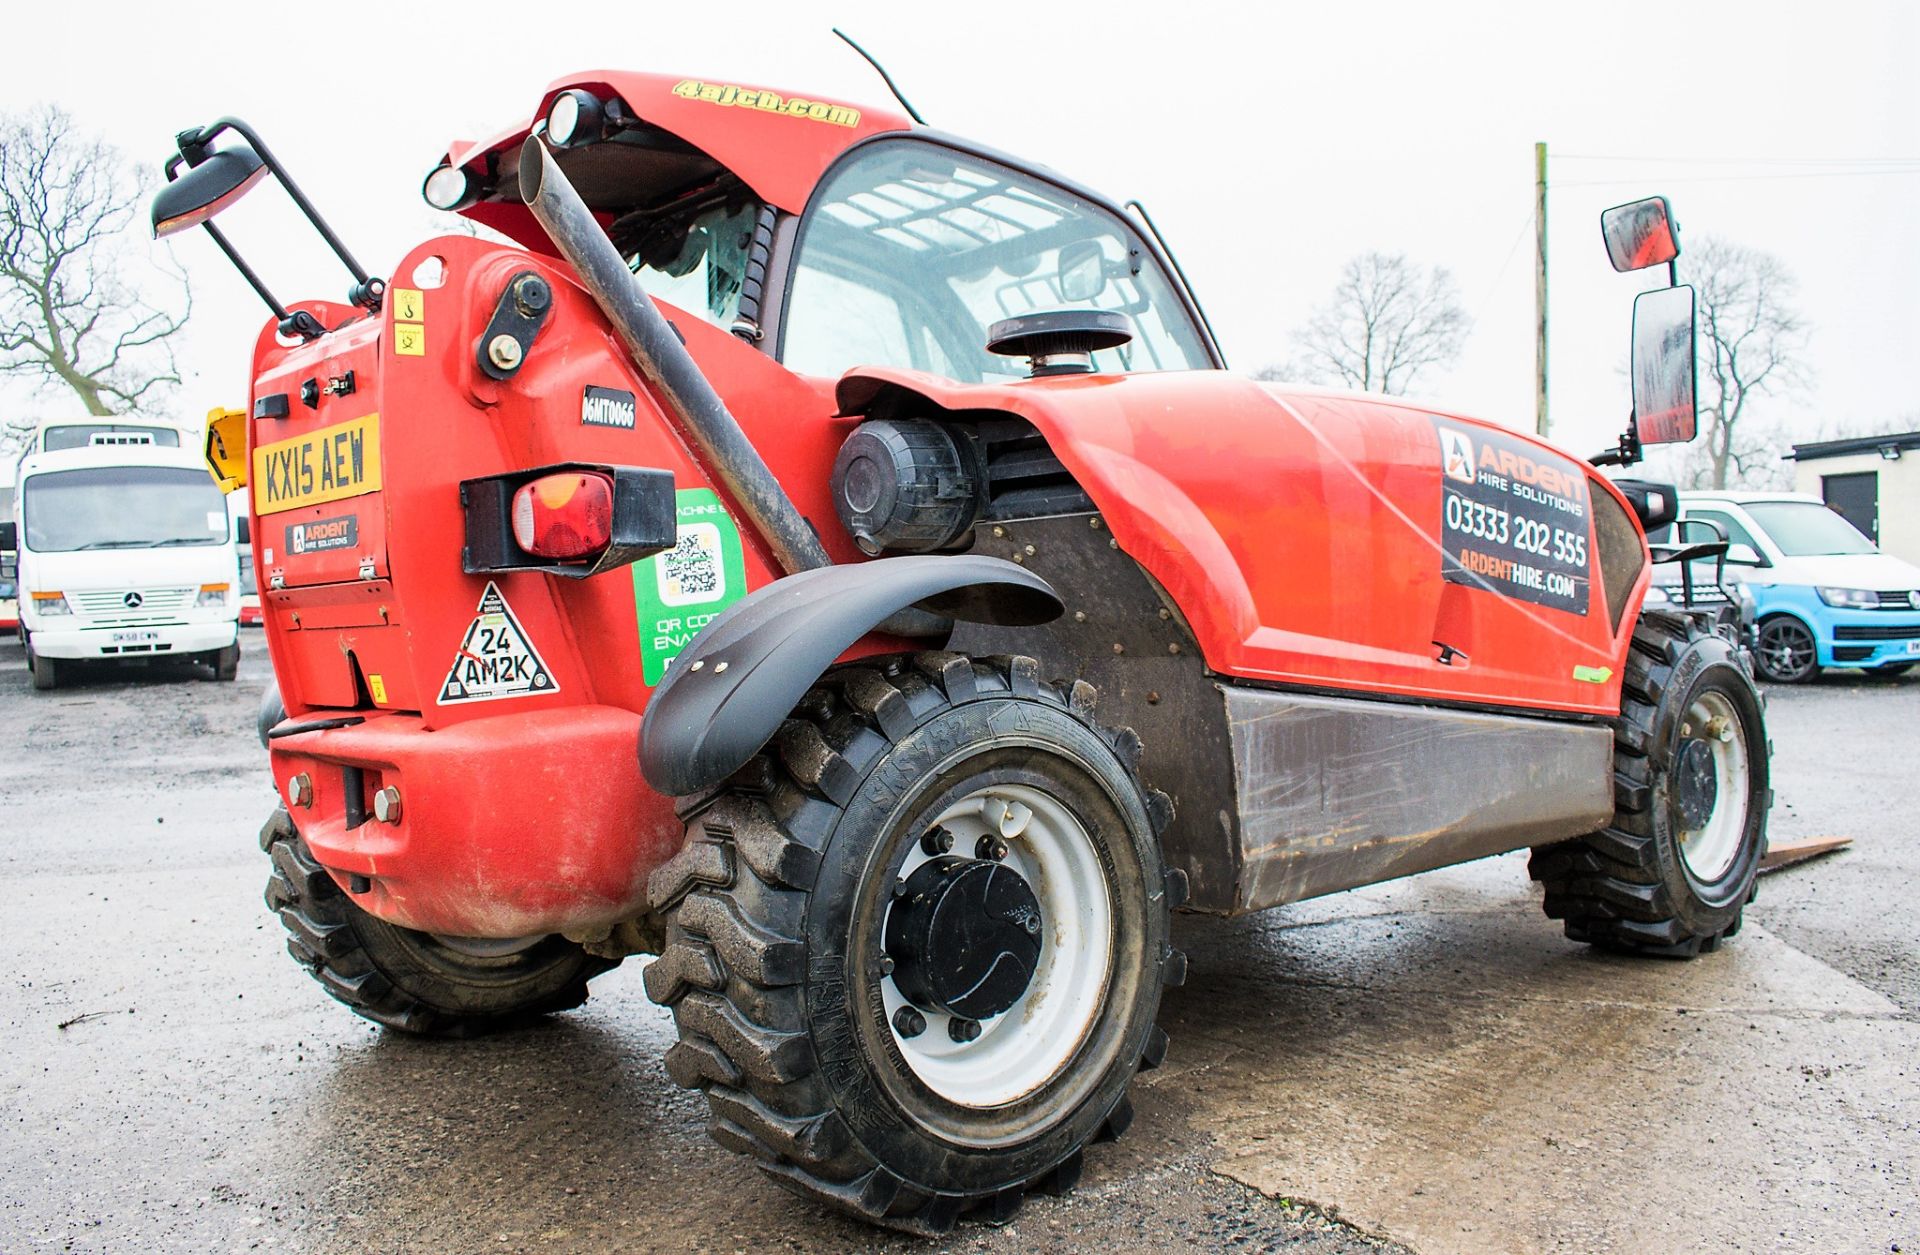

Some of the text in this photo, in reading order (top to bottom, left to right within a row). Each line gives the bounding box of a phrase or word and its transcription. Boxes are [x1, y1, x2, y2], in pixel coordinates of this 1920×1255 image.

[266, 427, 364, 502] KX15 AEW
[1478, 444, 1586, 499] ARDENT
[1478, 471, 1584, 517] HIRE SOLUTIONS
[676, 505, 717, 516] ACHINE
[305, 520, 349, 541] ARDENT
[318, 537, 348, 548] SOLUTIONS
[1446, 495, 1587, 568] 03333 202 555
[1460, 549, 1575, 599] ARDENTHIRE.COM
[480, 626, 511, 655] 24
[653, 632, 699, 650] ENA
[656, 618, 682, 634] QR
[465, 654, 531, 686] AM2K
